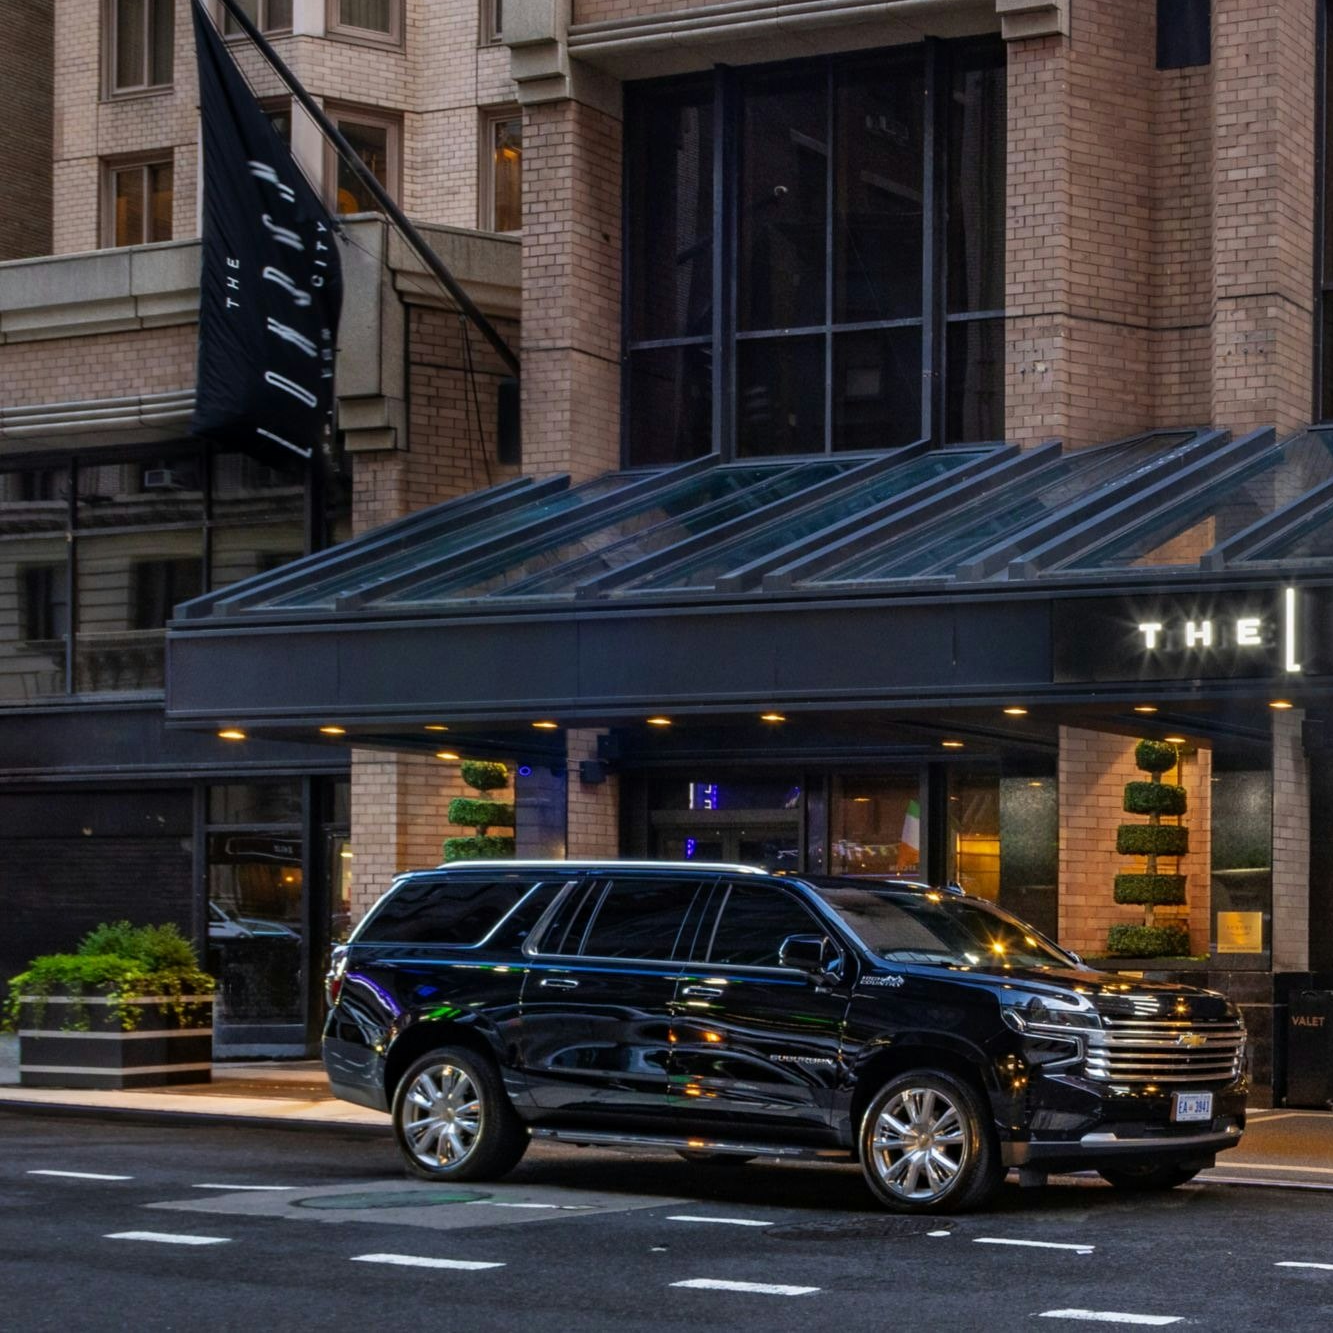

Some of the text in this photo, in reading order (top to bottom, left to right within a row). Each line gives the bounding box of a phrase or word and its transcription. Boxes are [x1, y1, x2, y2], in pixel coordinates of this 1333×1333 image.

[311, 221, 329, 288] CITY
[226, 257, 240, 309] THE
[1139, 619, 1262, 649] THE
[1291, 1016, 1325, 1026] VALET
